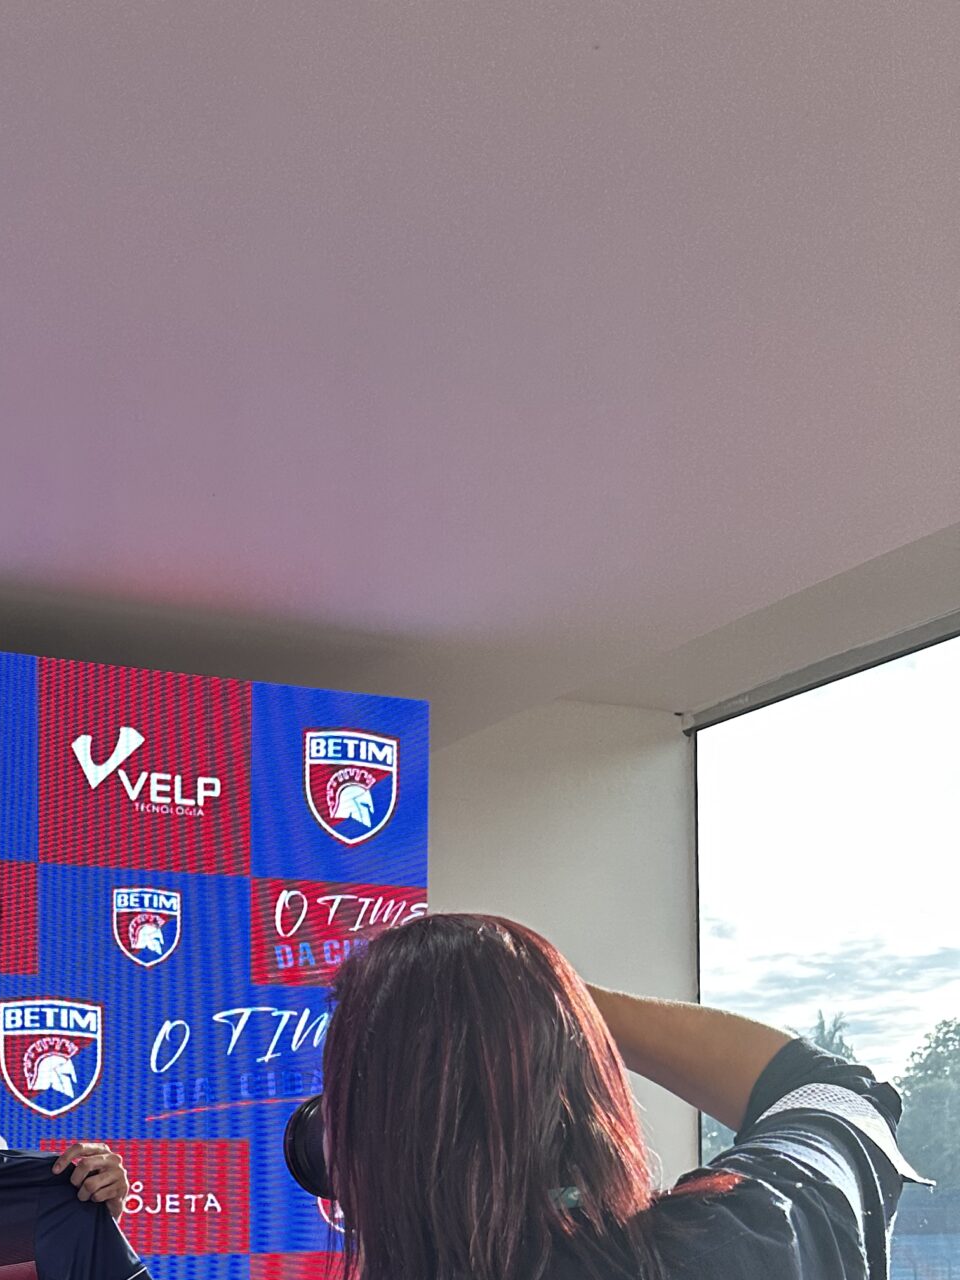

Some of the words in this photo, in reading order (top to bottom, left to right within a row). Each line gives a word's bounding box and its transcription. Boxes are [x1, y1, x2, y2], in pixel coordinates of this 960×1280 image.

[310, 737, 393, 766] BETIM
[118, 769, 221, 807] VELP
[135, 802, 205, 816] TECNOLOGIA
[116, 893, 178, 912] BETIM
[275, 890, 308, 937] O
[274, 942, 316, 969] DA
[4, 1009, 98, 1033] BETIM
[150, 1020, 190, 1073] O
[212, 1007, 328, 1062] TIM
[163, 1076, 214, 1108] DA
[240, 1069, 324, 1097] CIDA
[122, 1191, 222, 1214] OJETA
